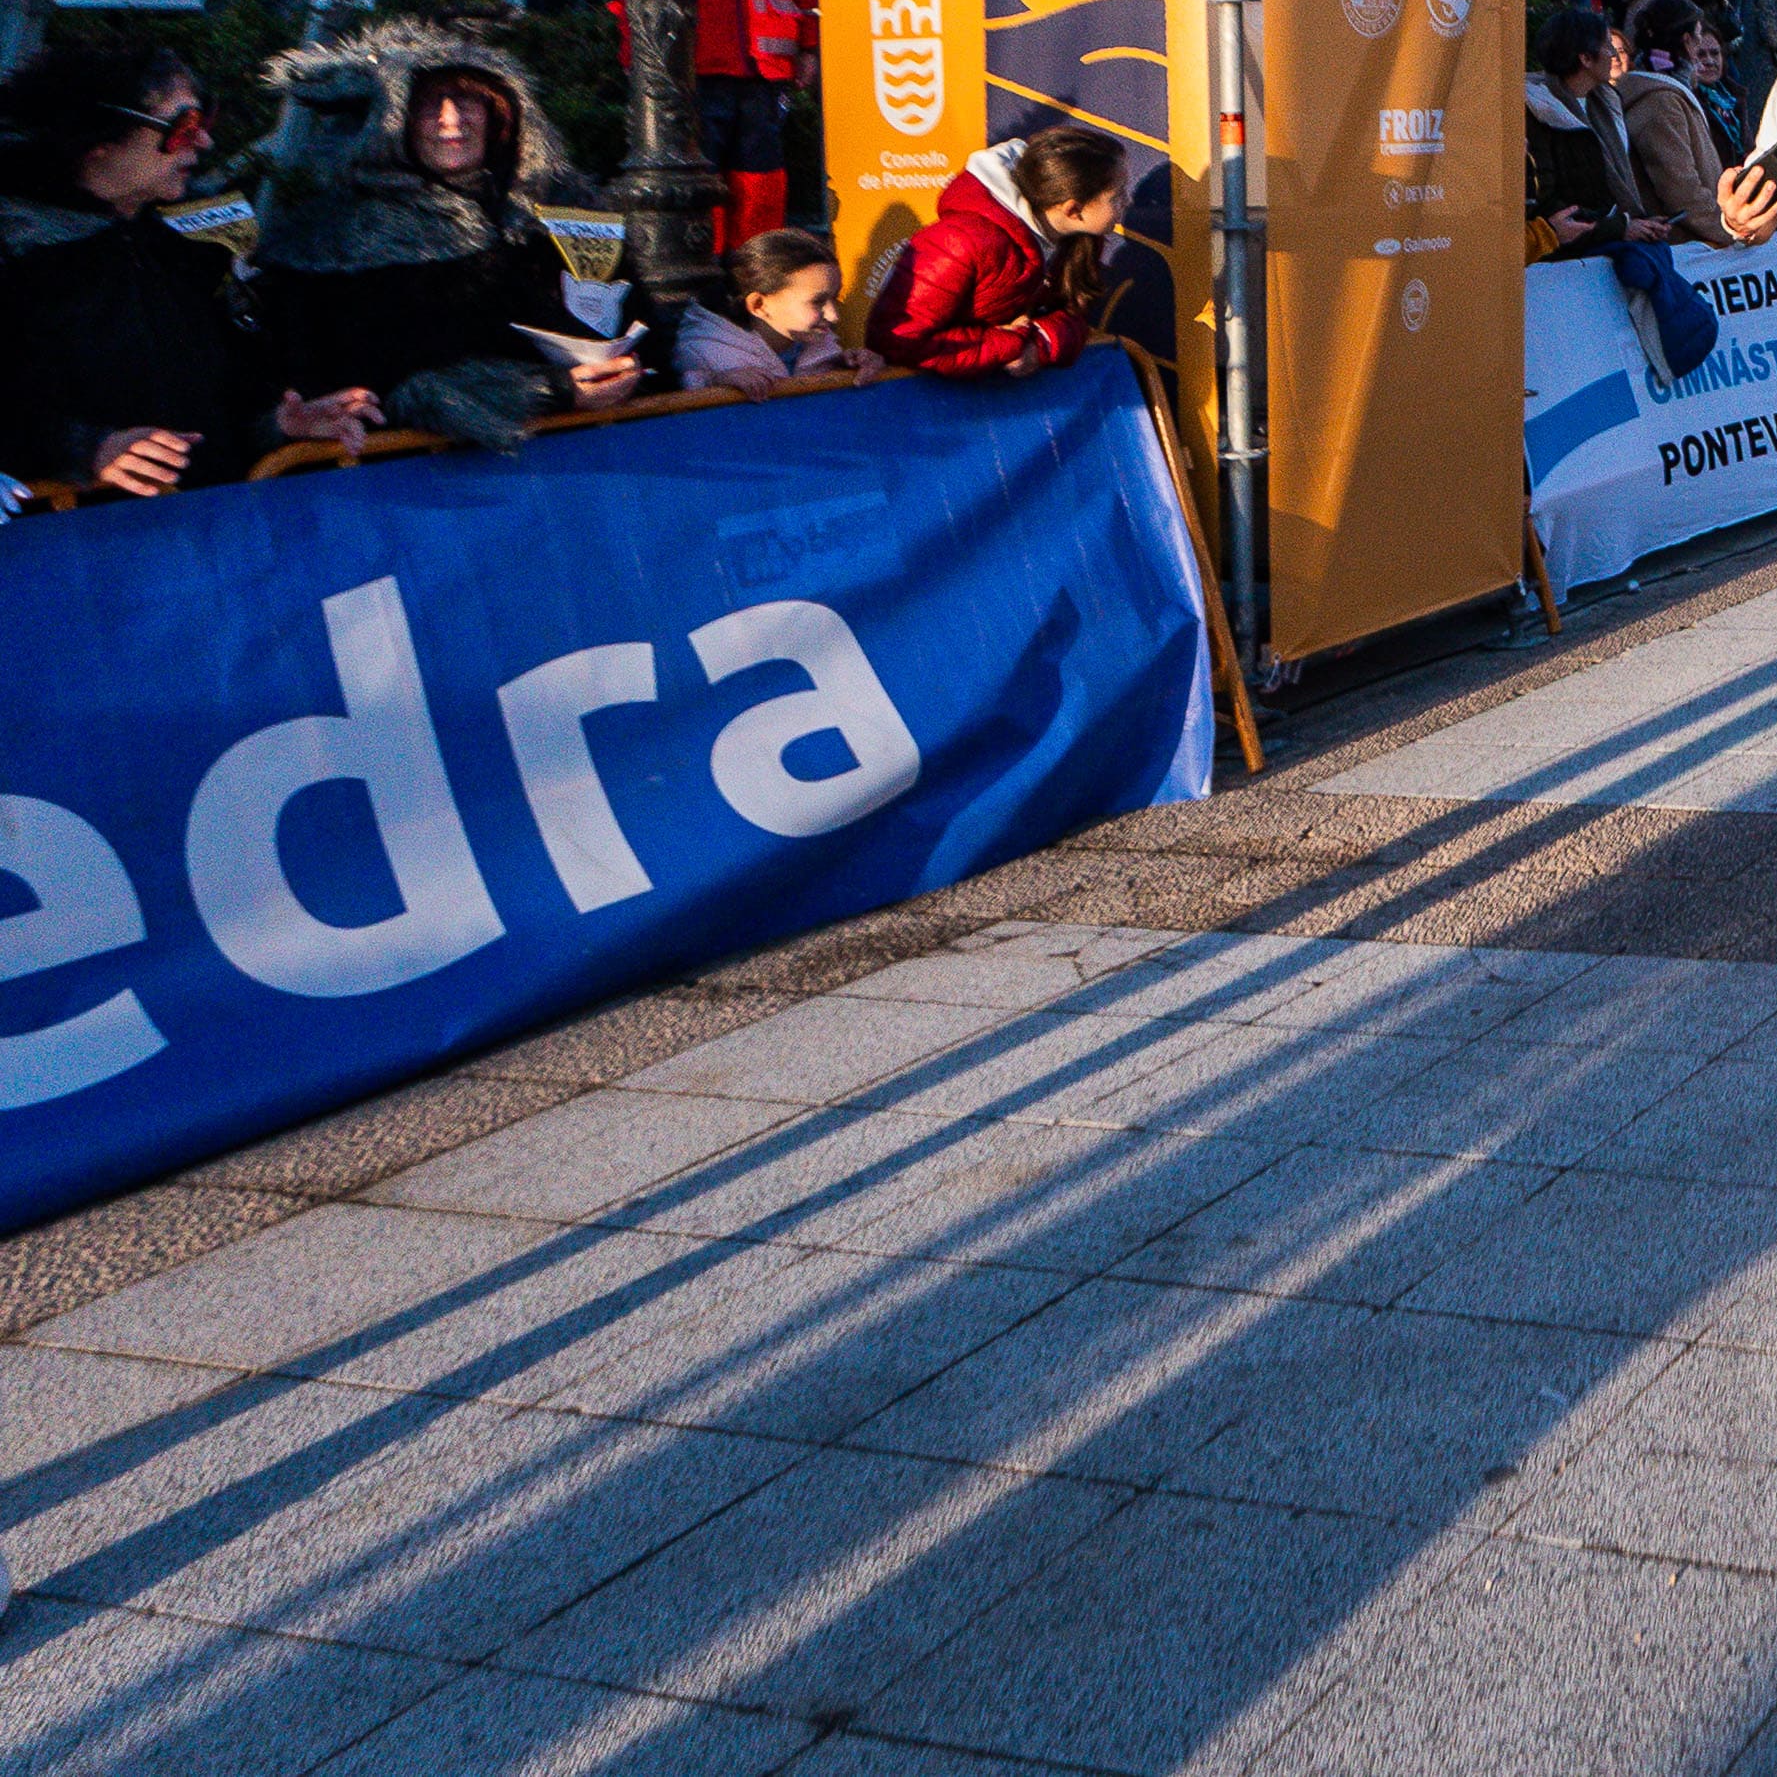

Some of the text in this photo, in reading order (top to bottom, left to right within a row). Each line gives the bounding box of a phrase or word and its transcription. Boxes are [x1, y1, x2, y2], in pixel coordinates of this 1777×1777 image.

[1378, 108, 1444, 141] FROIZ
[880, 150, 949, 169] Concello
[858, 171, 881, 190] de
